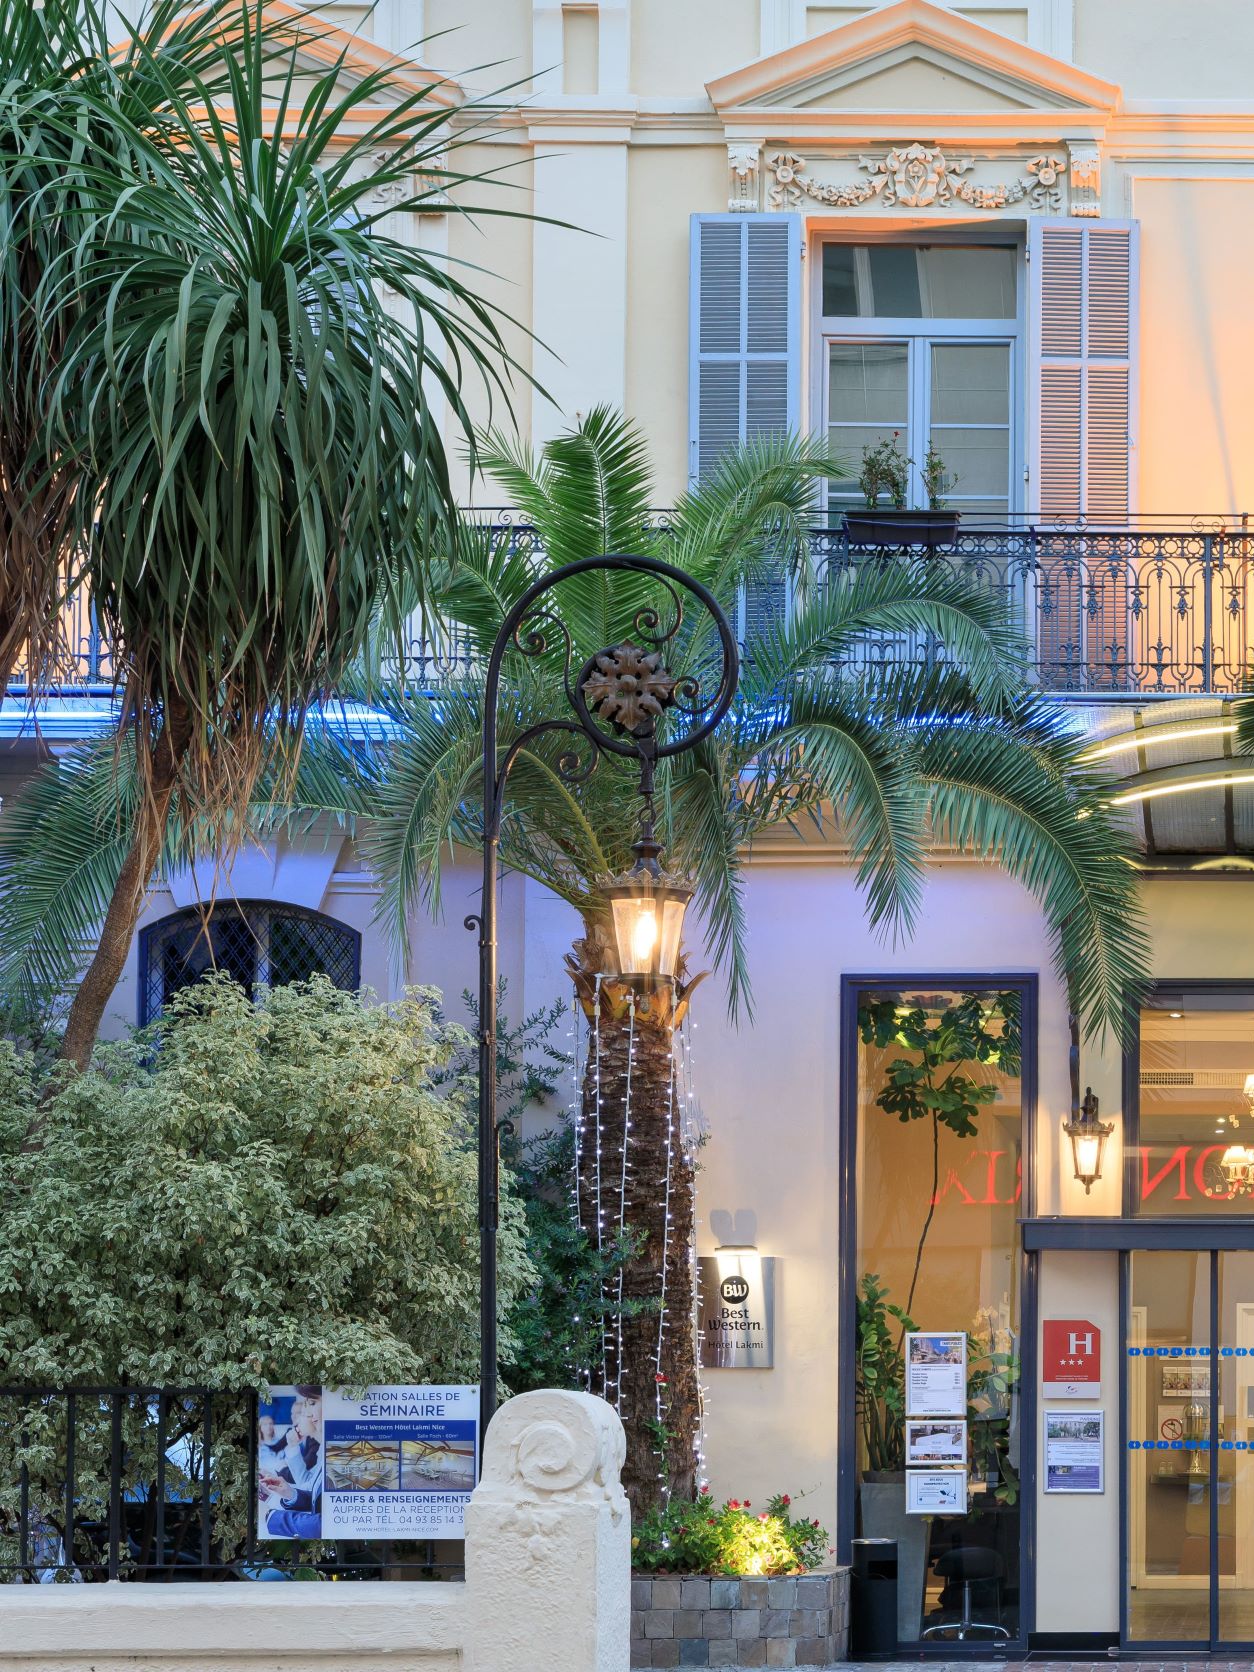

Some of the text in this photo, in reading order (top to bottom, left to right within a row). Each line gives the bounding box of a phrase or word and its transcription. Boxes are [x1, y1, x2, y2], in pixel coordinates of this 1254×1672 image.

[723, 1284, 747, 1297] BW
[721, 1307, 749, 1319] Best
[708, 1319, 761, 1331] Western
[735, 1340, 764, 1349] Lakmi
[1067, 1332, 1095, 1355] H
[342, 1392, 460, 1401] LATION SALLES DE
[360, 1402, 445, 1417] SÉMINAIRE
[329, 1495, 471, 1504] TARIFS & RENSEIGNEMENTS
[333, 1504, 374, 1514] AUPRÈS
[376, 1505, 391, 1514] DE
[393, 1505, 407, 1514] LA
[333, 1515, 349, 1525] OU
[352, 1515, 372, 1525] PAR
[399, 1515, 412, 1525] 04
[415, 1515, 428, 1525] 93
[430, 1515, 442, 1525] 85
[445, 1515, 455, 1525] 14
